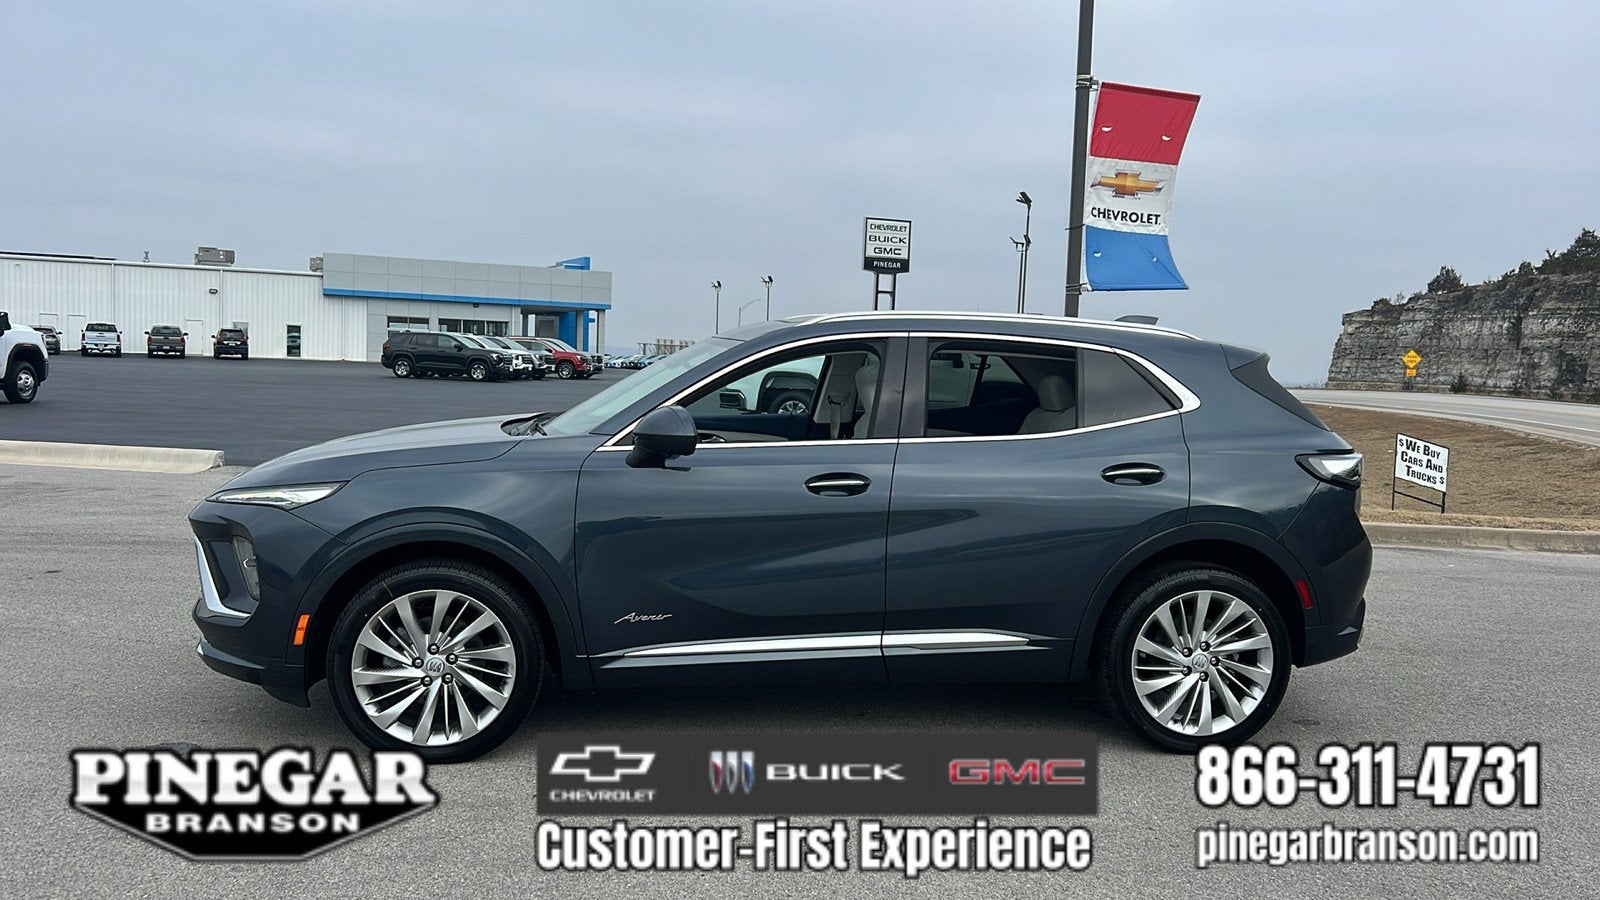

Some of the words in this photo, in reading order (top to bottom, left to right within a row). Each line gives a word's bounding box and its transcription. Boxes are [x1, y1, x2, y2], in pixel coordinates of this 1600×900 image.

[1090, 206, 1161, 226] CHEVROLET
[869, 223, 908, 233] CHEVROLET
[868, 234, 907, 245] BUICK
[873, 246, 902, 256] GMC
[873, 260, 901, 269] PINEGAR
